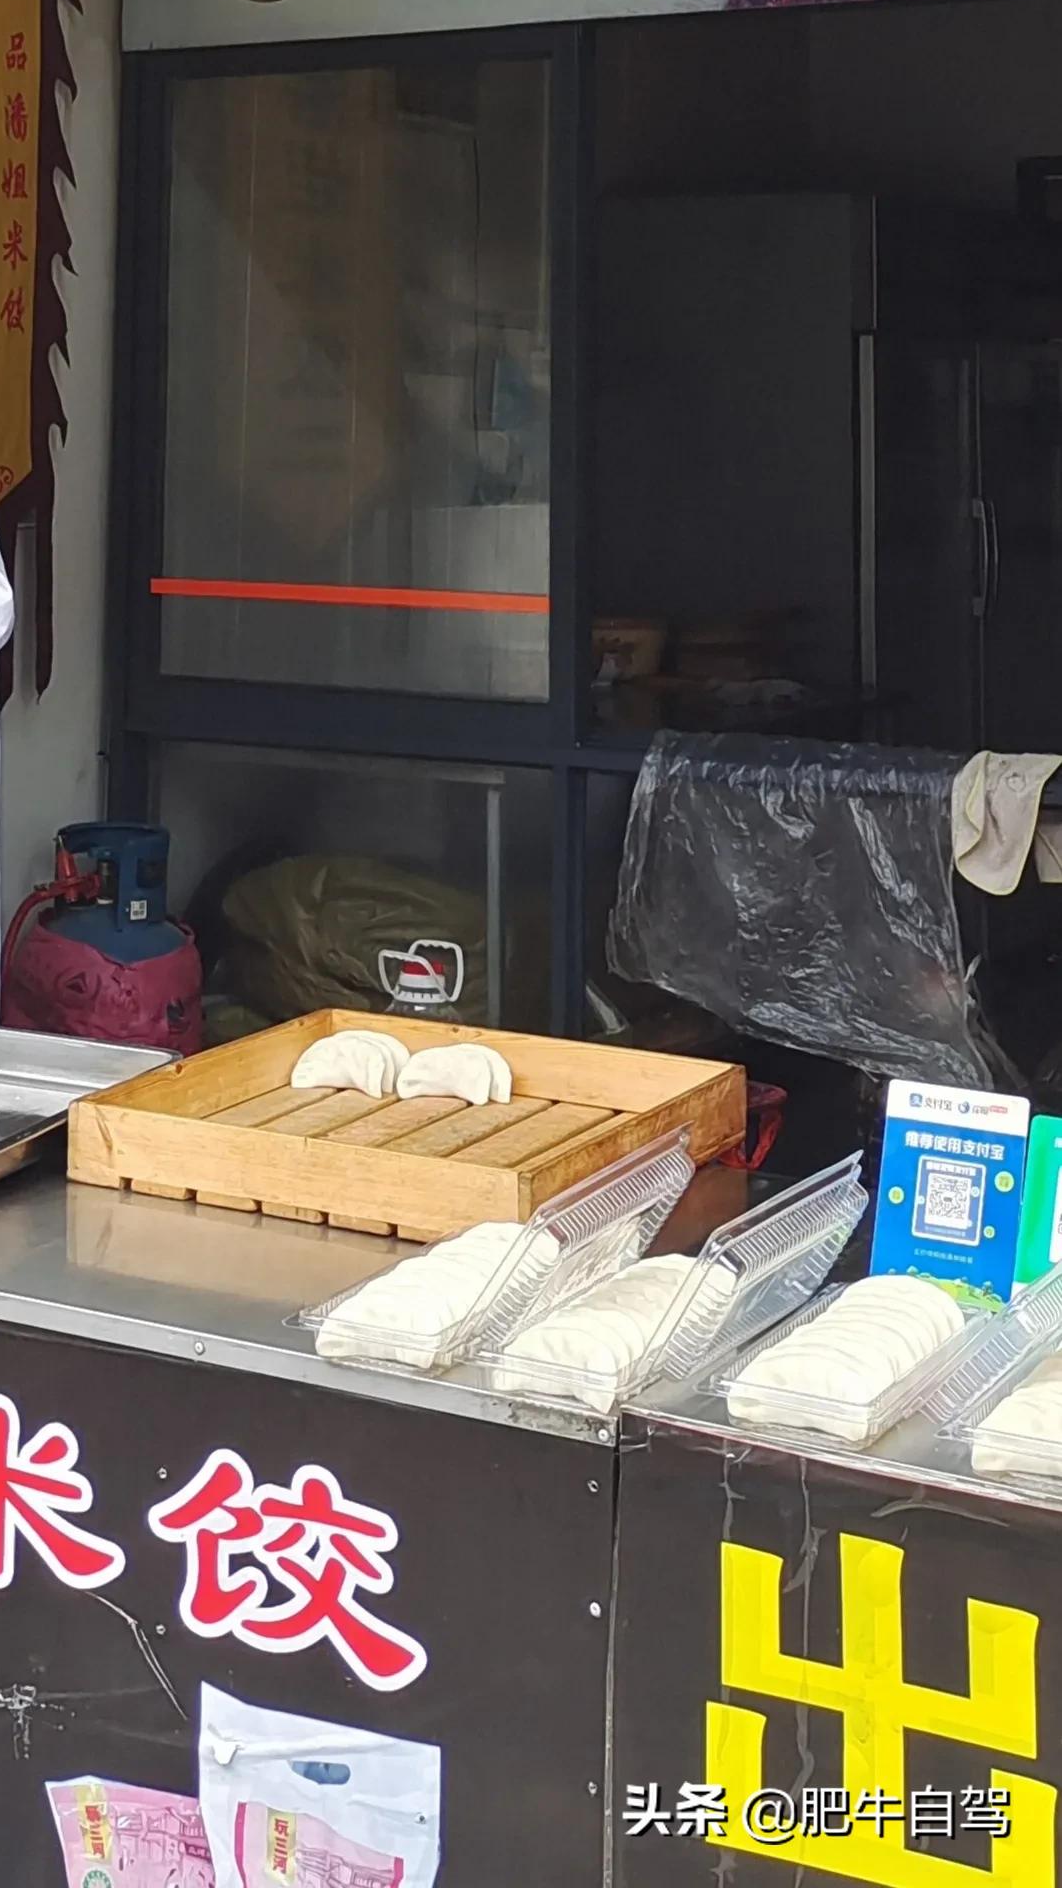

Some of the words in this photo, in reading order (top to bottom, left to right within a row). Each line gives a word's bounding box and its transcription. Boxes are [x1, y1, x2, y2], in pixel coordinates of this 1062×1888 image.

[0, 30, 29, 335] 品潘姐米饺
[904, 1130, 1006, 1161] 推荐使用支付宝
[705, 1532, 1057, 1888] 出
